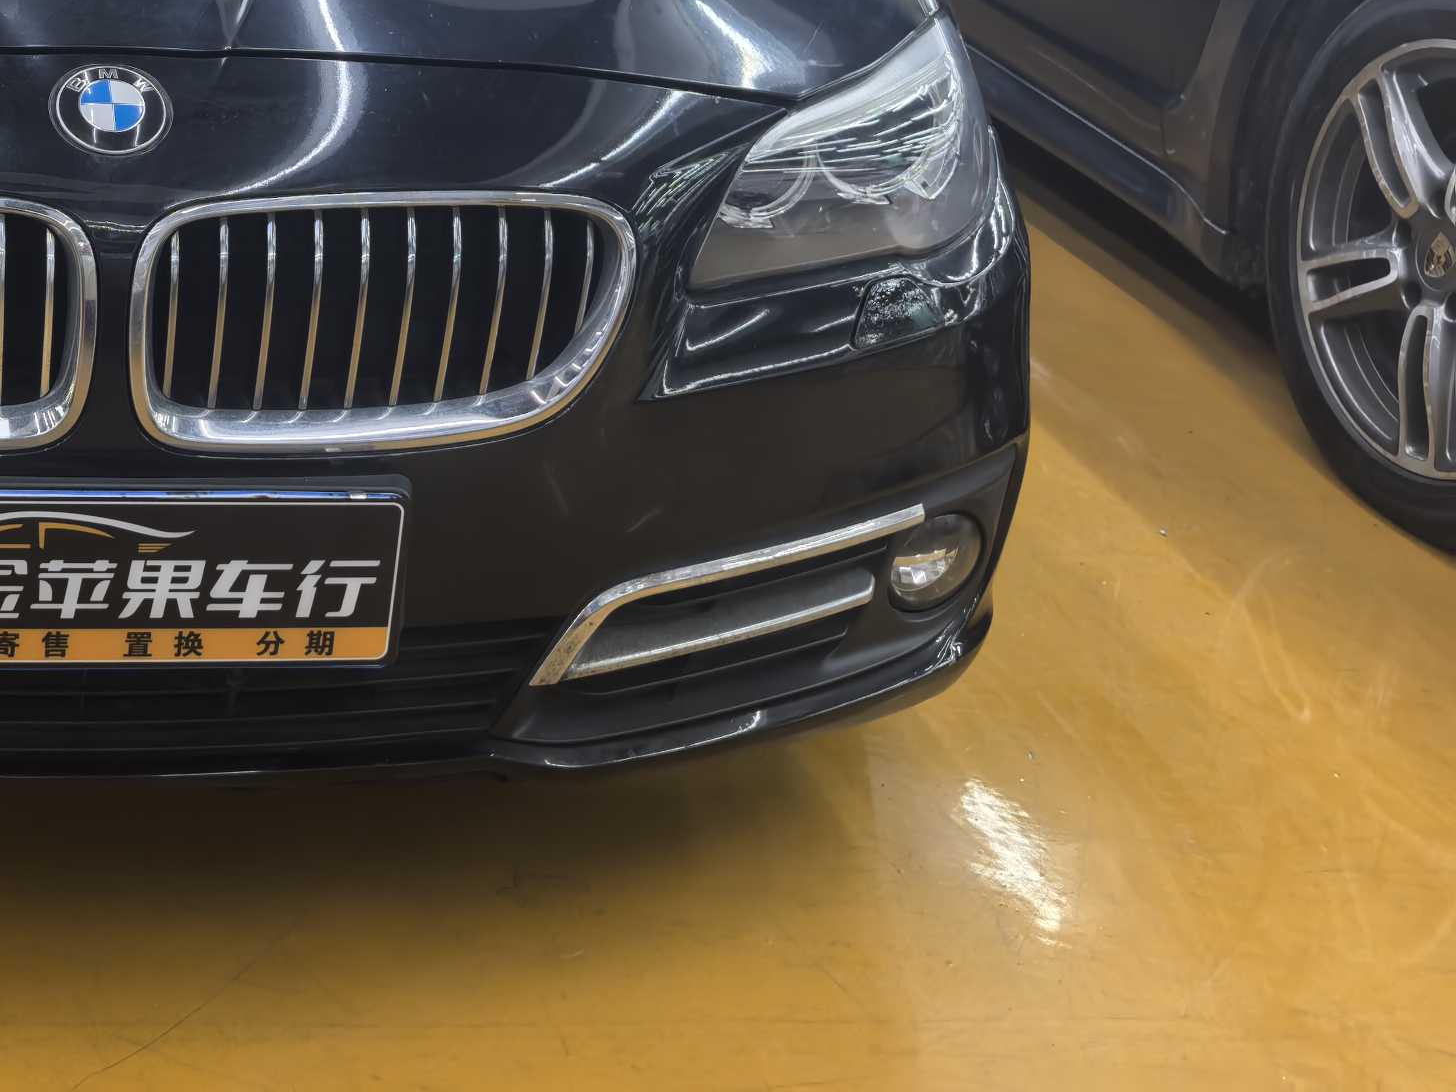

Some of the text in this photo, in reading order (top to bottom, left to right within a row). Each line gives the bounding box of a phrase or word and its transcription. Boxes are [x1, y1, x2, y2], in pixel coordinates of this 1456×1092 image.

[65, 67, 154, 94] BMW
[123, 630, 204, 658] 置换
[255, 630, 336, 658] 分期
